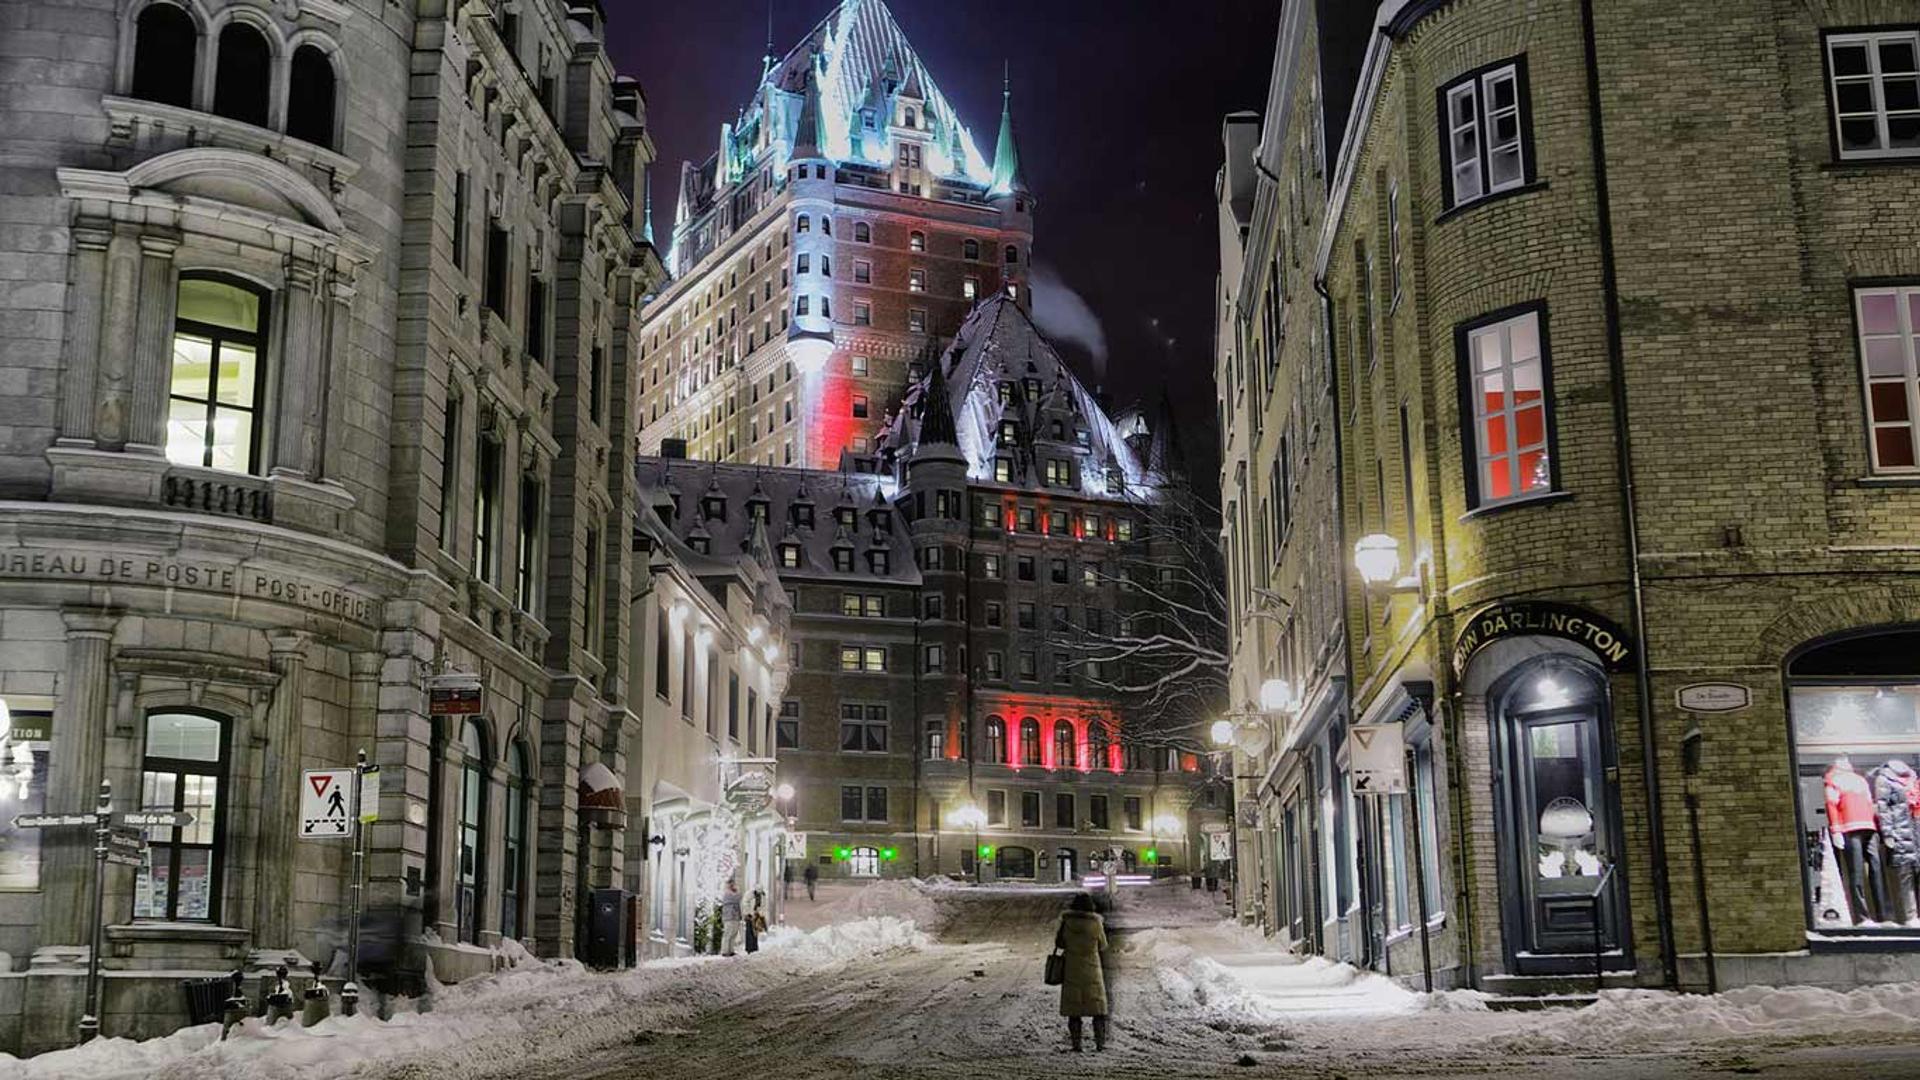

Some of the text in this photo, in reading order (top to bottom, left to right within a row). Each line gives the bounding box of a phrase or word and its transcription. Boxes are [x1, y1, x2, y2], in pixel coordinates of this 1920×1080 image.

[100, 558, 133, 577] DE
[146, 561, 233, 588] POSTE
[254, 576, 371, 620] POST-OFFICE
[1481, 611, 1628, 662] DARLINGTON
[13, 728, 42, 739] TION
